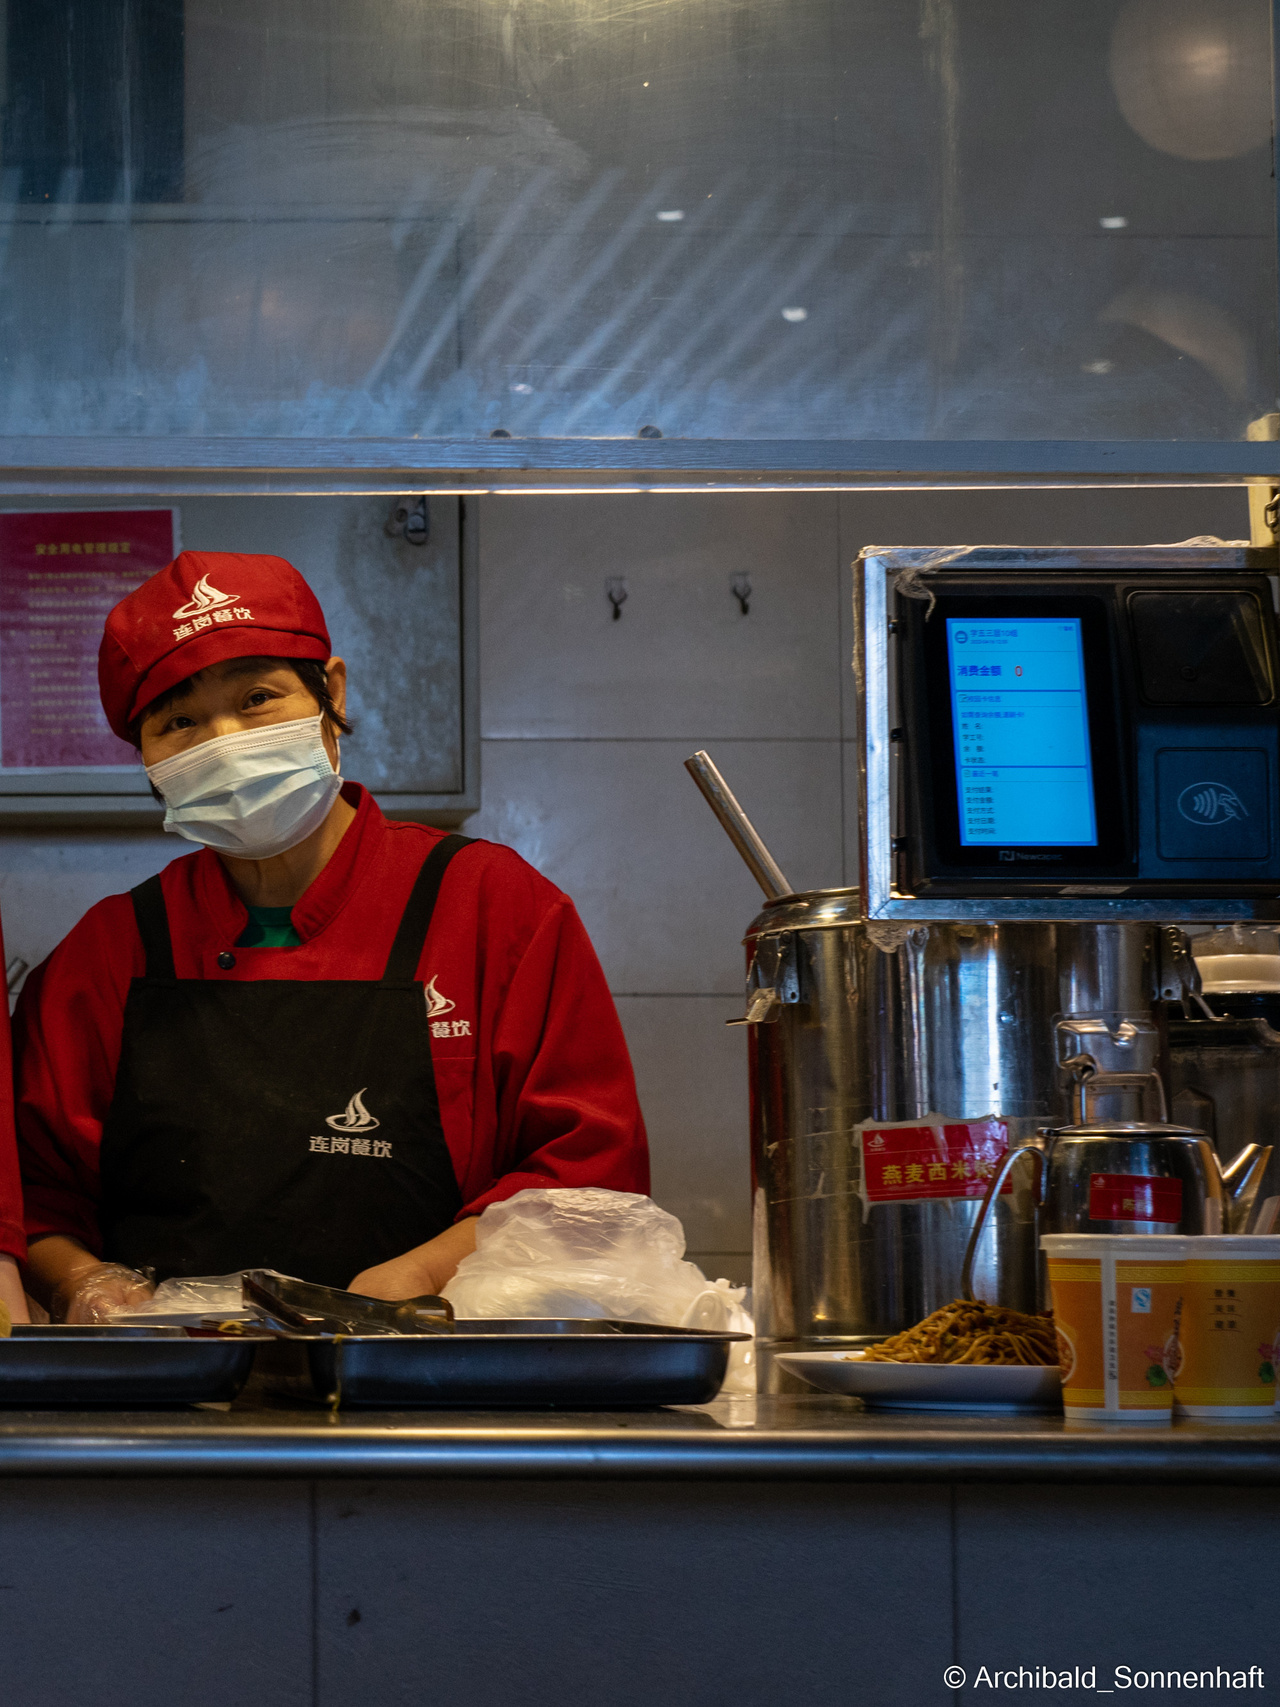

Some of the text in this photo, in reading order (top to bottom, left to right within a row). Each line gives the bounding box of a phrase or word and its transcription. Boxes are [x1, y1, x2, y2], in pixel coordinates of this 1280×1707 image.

[172, 607, 255, 642] 连岗餐饮
[957, 664, 1023, 677] 消费金额 0
[308, 1135, 393, 1159] 连岗餐饮
